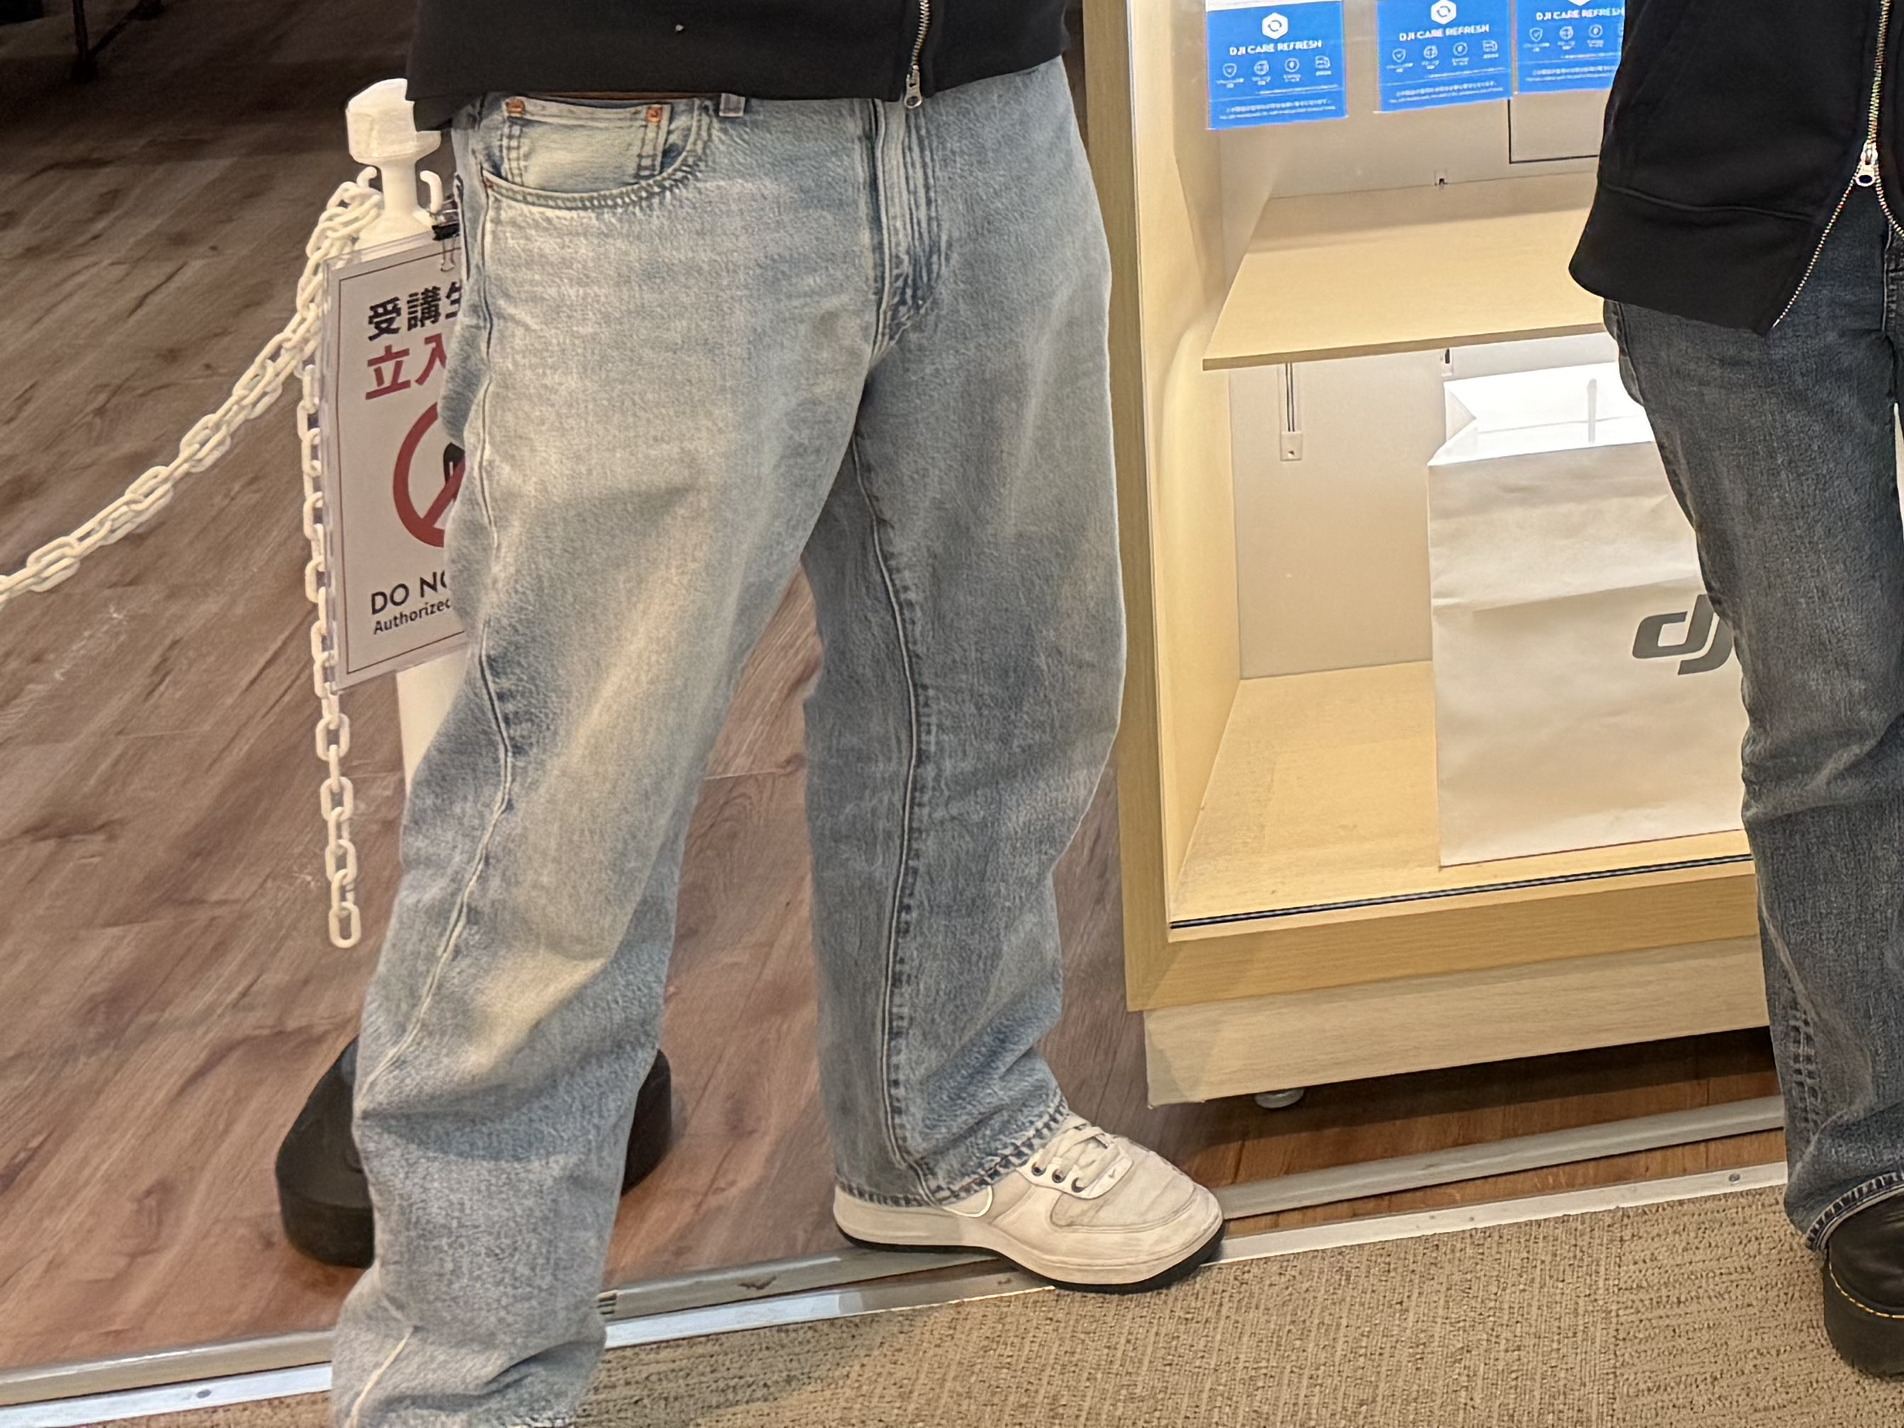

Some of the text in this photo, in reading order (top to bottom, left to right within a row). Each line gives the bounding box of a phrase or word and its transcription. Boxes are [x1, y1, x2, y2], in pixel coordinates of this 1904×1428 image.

[1536, 11, 1551, 21] DJI
[1553, 9, 1580, 20] CARE
[1399, 24, 1489, 42] DJI CARE REFRESH
[1229, 40, 1323, 56] DJI CARE REFRESH
[371, 583, 409, 615] DO
